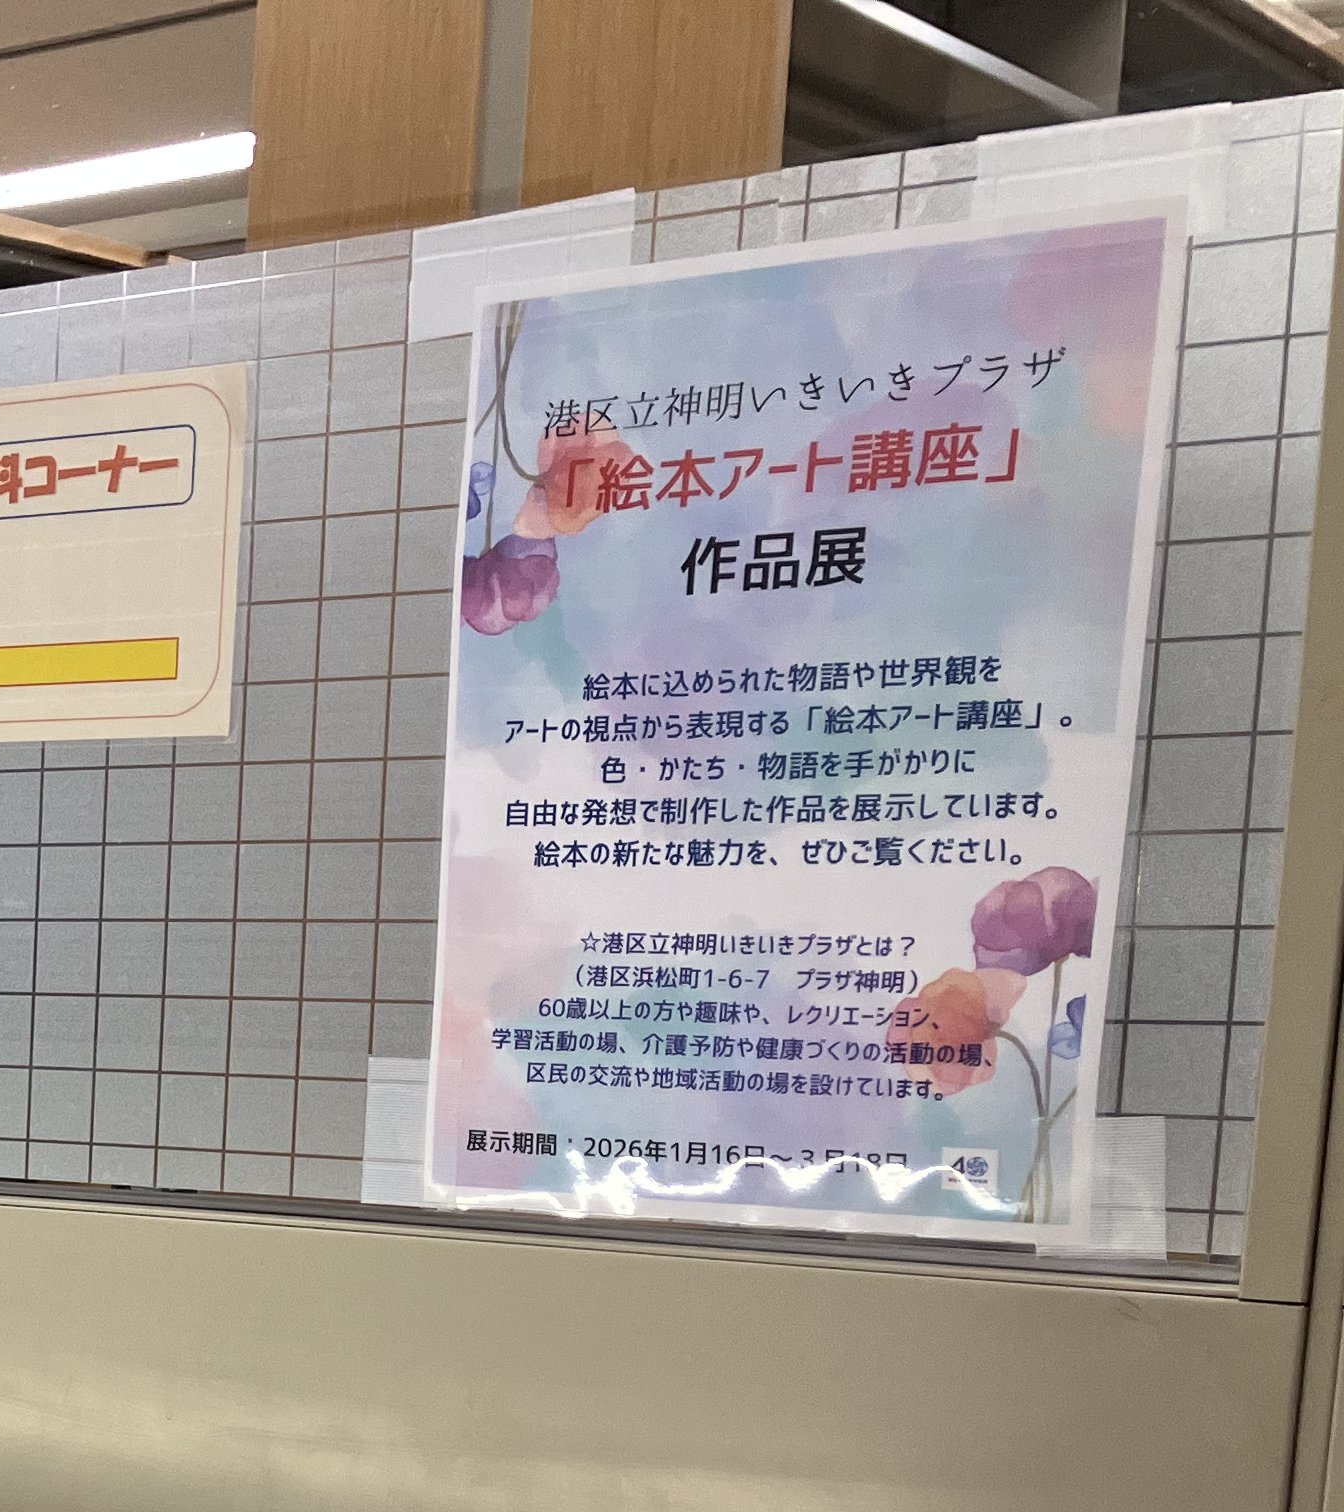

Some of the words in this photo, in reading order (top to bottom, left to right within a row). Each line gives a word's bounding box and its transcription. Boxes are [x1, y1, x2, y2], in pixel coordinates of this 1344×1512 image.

[544, 347, 1067, 440] 港区立神明いきいきプラザ
[564, 423, 1020, 515] 「絵本アート講座」
[679, 526, 869, 596] 作品展
[582, 654, 1002, 702] 絵本に込められた物語や世界観を
[504, 698, 1075, 744] アートの視点から表現する「絵本アート講座」。
[601, 748, 977, 785] 色・かたち・物語を手がかりに
[504, 793, 1060, 829] 自由な発想で制作した作品を展示しています。
[533, 838, 1024, 869] 絵本の新たな魅力を、ぜひご覧ください。
[574, 964, 770, 991] （港区浜松町1-6-7
[795, 967, 921, 997] プラザ神明）
[537, 997, 943, 1032] 60歳以上の方や趣味や、レクリエーション、
[490, 1028, 995, 1070] 学習活動の場、介護予防や健康づくりの活動の場、
[525, 1061, 946, 1104] 区民の交流や地域活動の場を設けています。
